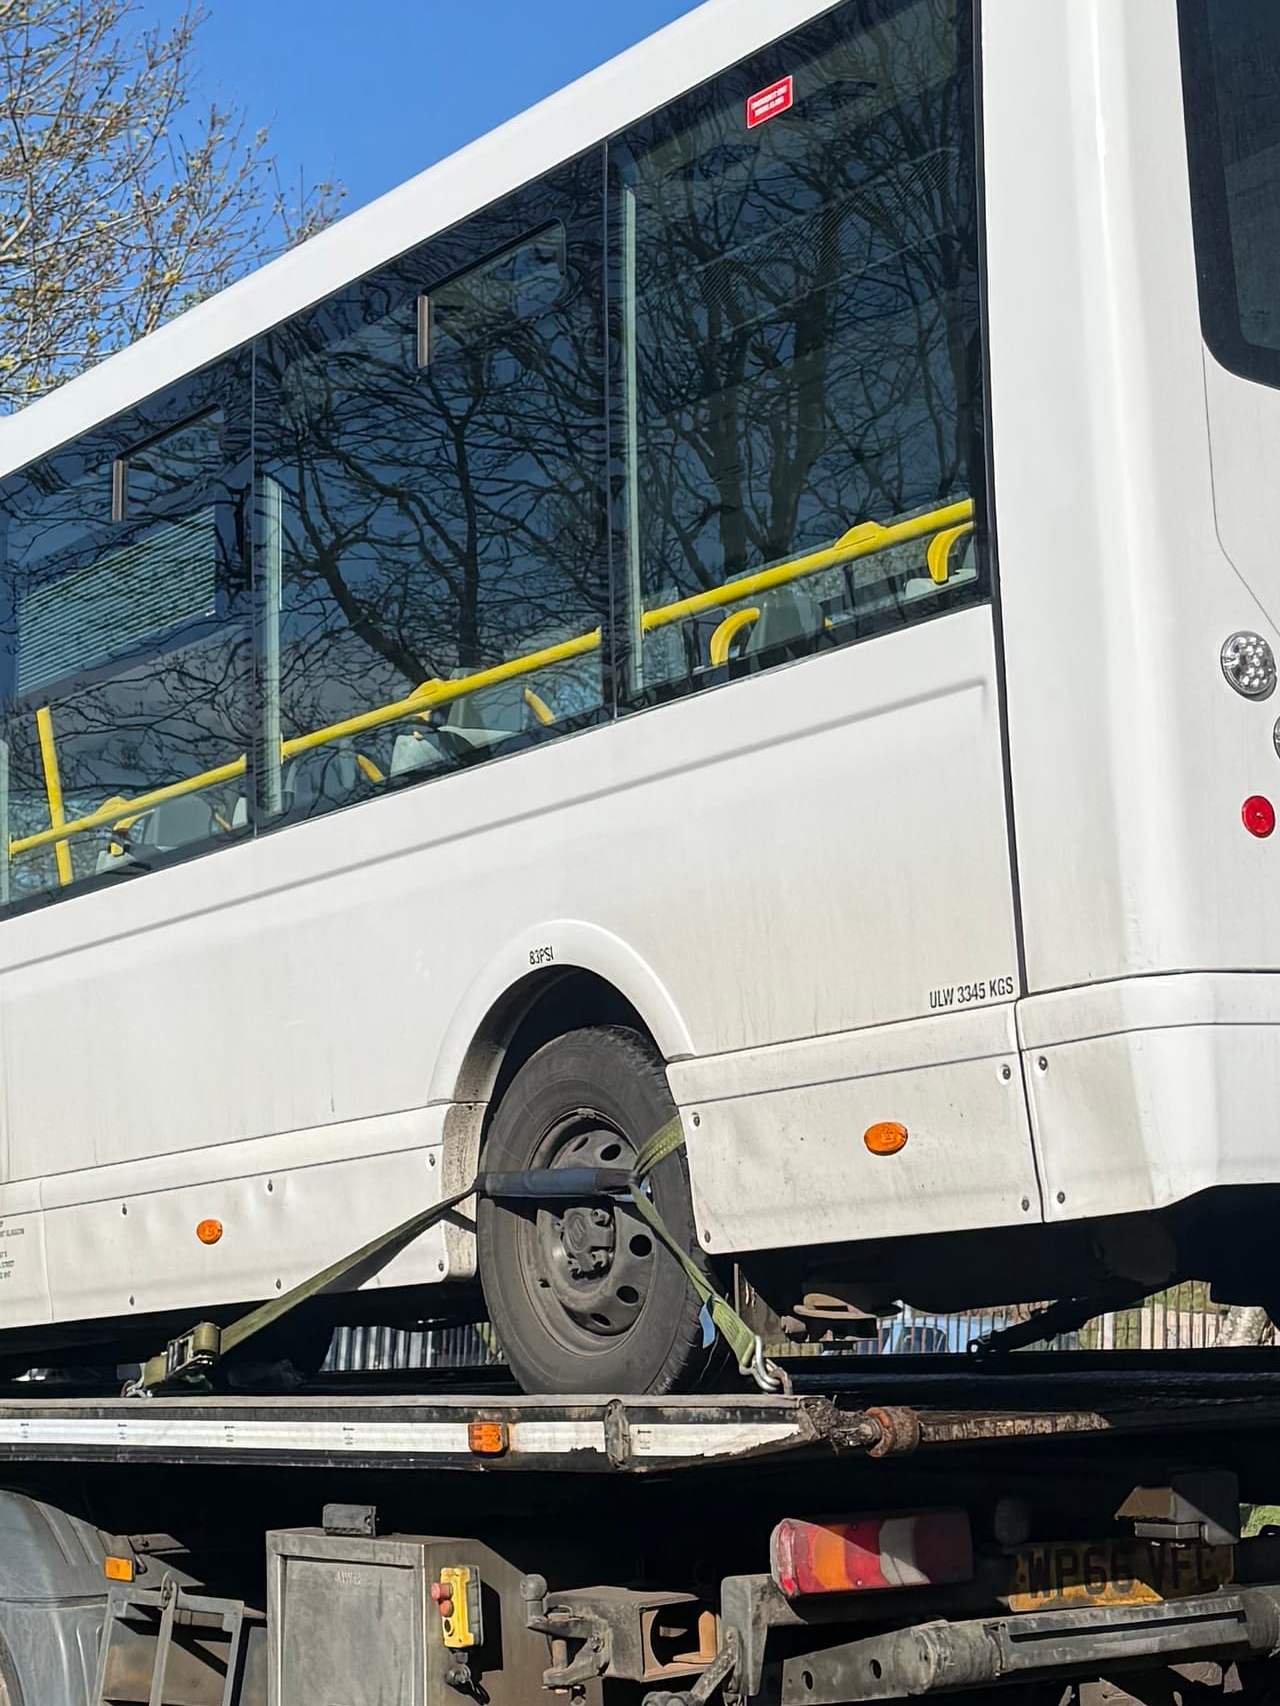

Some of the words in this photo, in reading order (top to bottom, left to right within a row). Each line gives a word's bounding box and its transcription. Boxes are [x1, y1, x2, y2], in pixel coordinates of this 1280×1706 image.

[930, 987, 954, 1008] ULW
[957, 982, 986, 1003] 3345
[989, 976, 1014, 998] KGS
[1028, 1546, 1133, 1599] WP66
